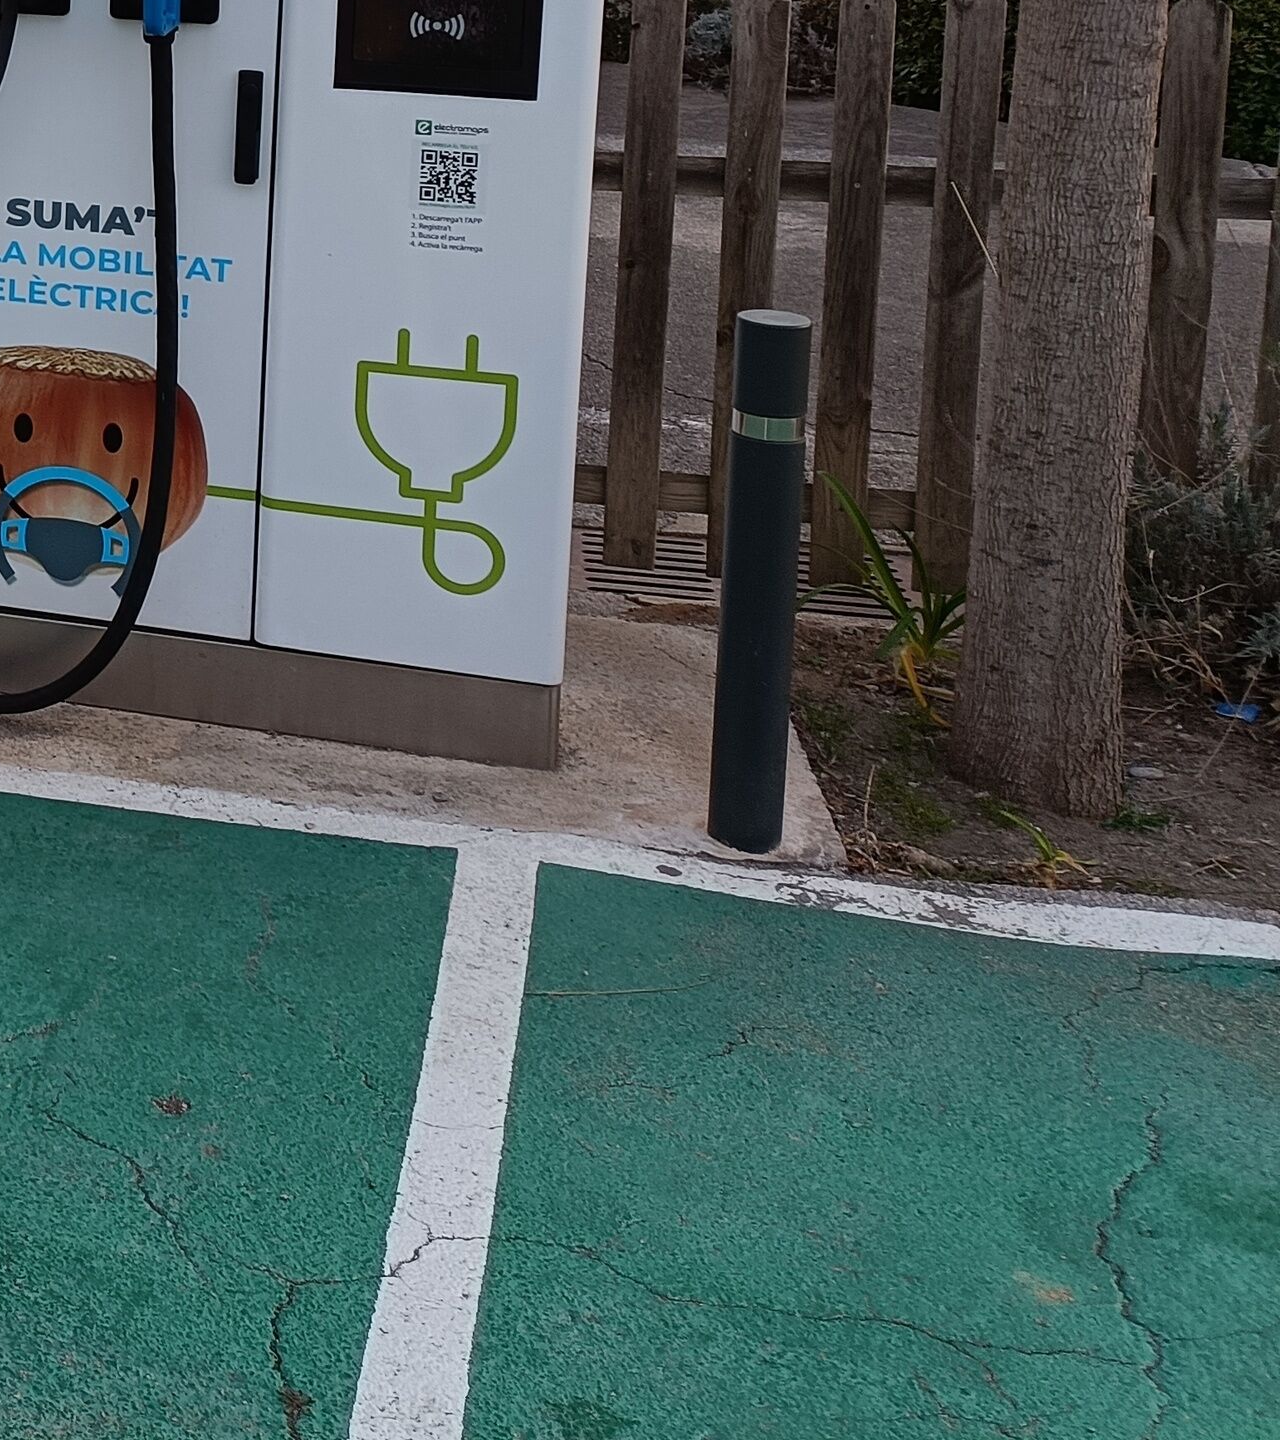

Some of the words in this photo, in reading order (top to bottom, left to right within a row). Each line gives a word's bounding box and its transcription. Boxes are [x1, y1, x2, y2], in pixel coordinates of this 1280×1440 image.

[433, 123, 489, 134] electromaps
[5, 197, 156, 236] SUMA'
[38, 243, 233, 283] MOBILAT
